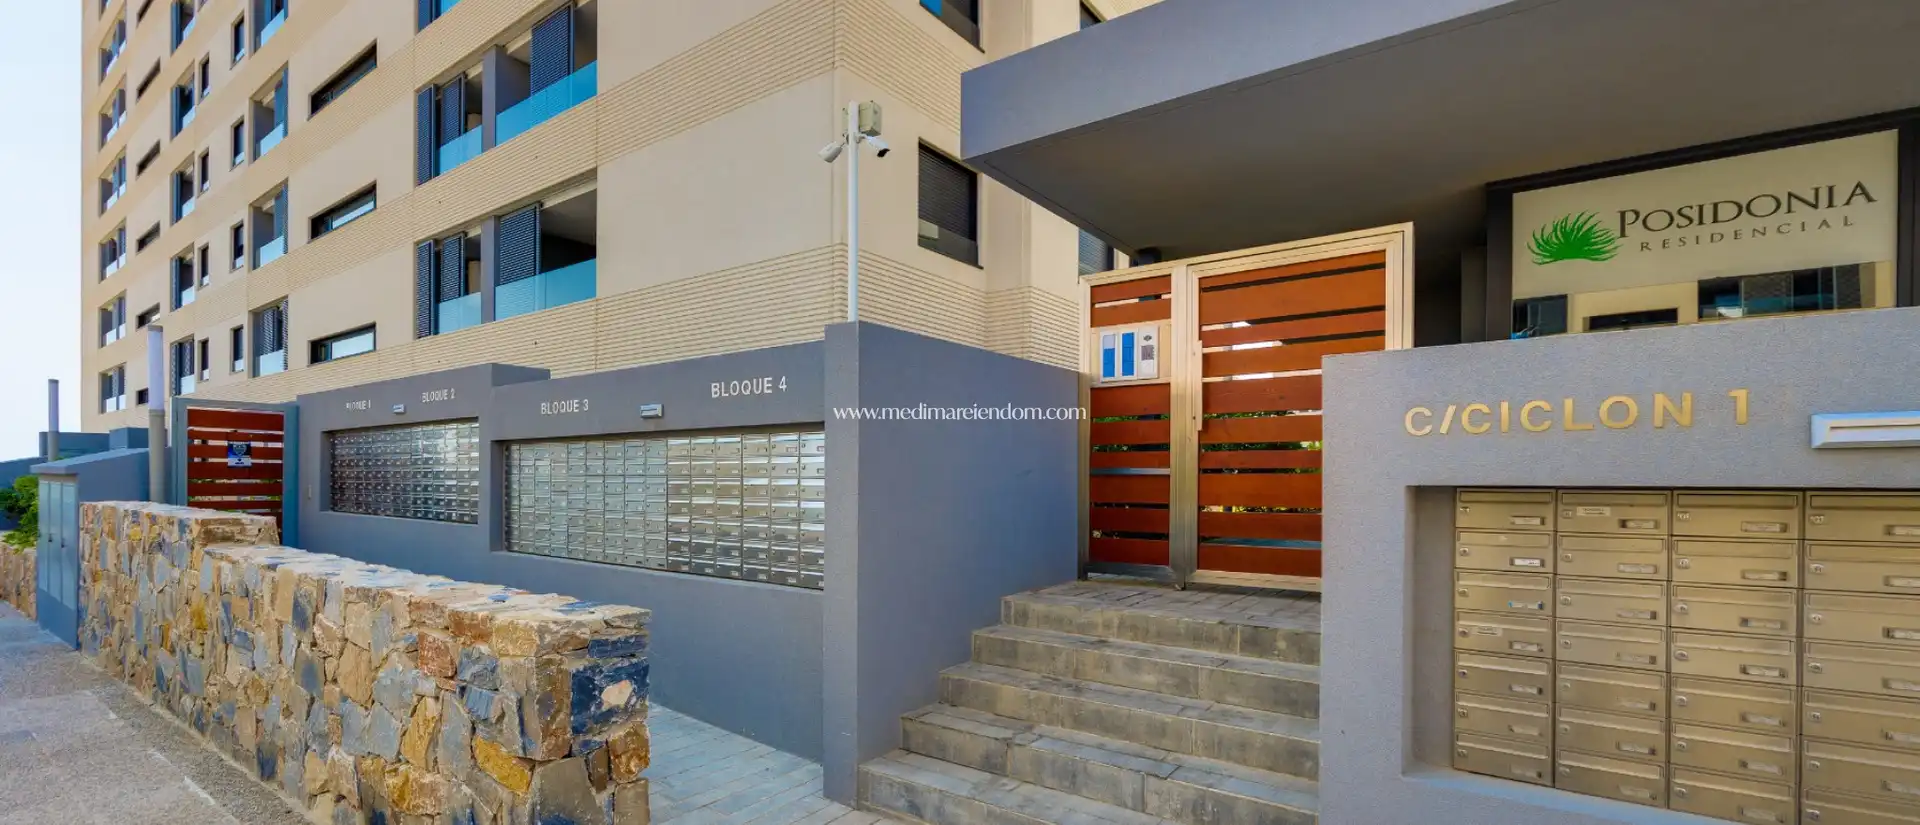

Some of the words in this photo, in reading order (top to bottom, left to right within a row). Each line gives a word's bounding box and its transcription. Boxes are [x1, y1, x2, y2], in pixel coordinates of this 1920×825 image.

[1617, 180, 1878, 238] POSIDONIA
[1640, 215, 1854, 252] RESIDENCIAL
[421, 389, 448, 403] BLOQUE
[711, 377, 772, 398] BLOQUE
[778, 376, 787, 392] 4
[541, 400, 580, 414] BLOQUE
[582, 400, 589, 411] 3
[1404, 391, 1693, 437] C/CICLON
[1728, 388, 1750, 425] 1
